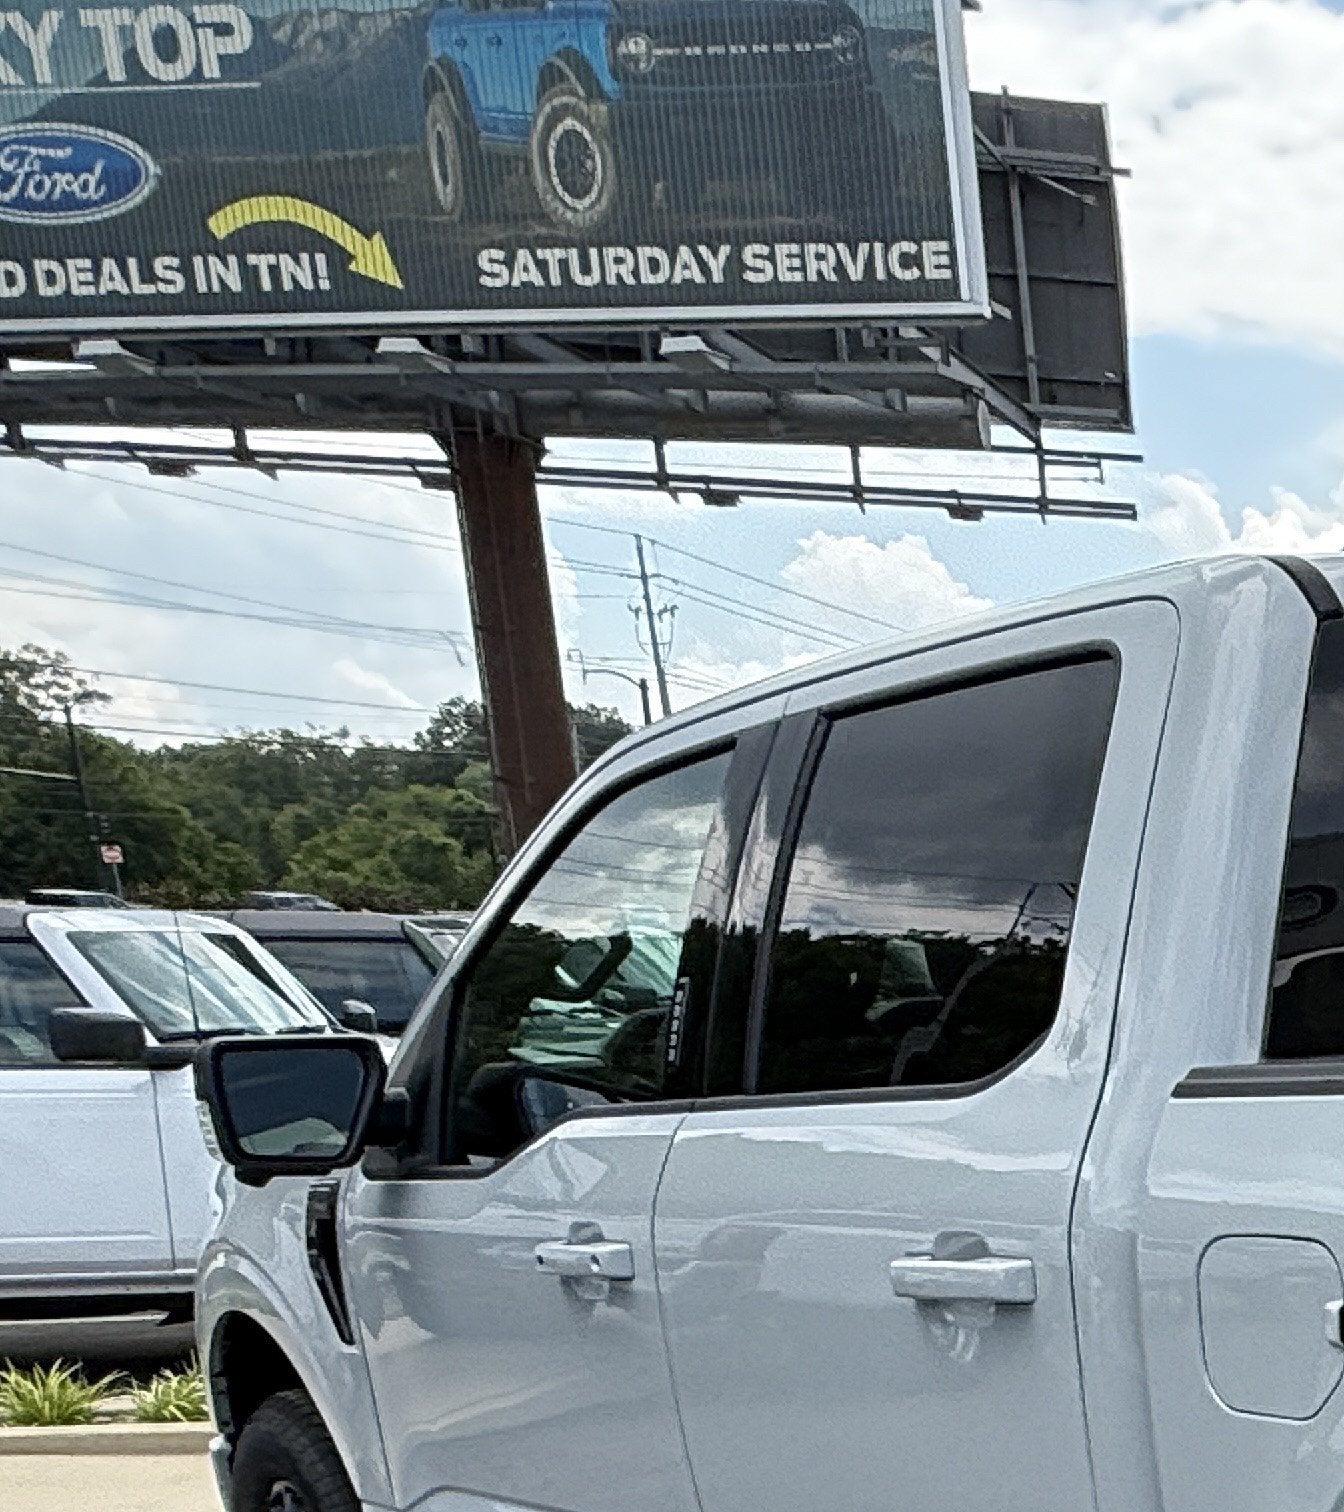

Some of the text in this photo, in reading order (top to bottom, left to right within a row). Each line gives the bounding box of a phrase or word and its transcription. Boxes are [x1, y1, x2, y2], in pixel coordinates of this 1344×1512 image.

[79, 4, 252, 82] TOP
[0, 144, 106, 201] Ford
[34, 256, 185, 297] DEALS
[193, 254, 241, 294] IN
[247, 252, 331, 292] TN!
[478, 241, 953, 288] SATURDAY SERVICE
